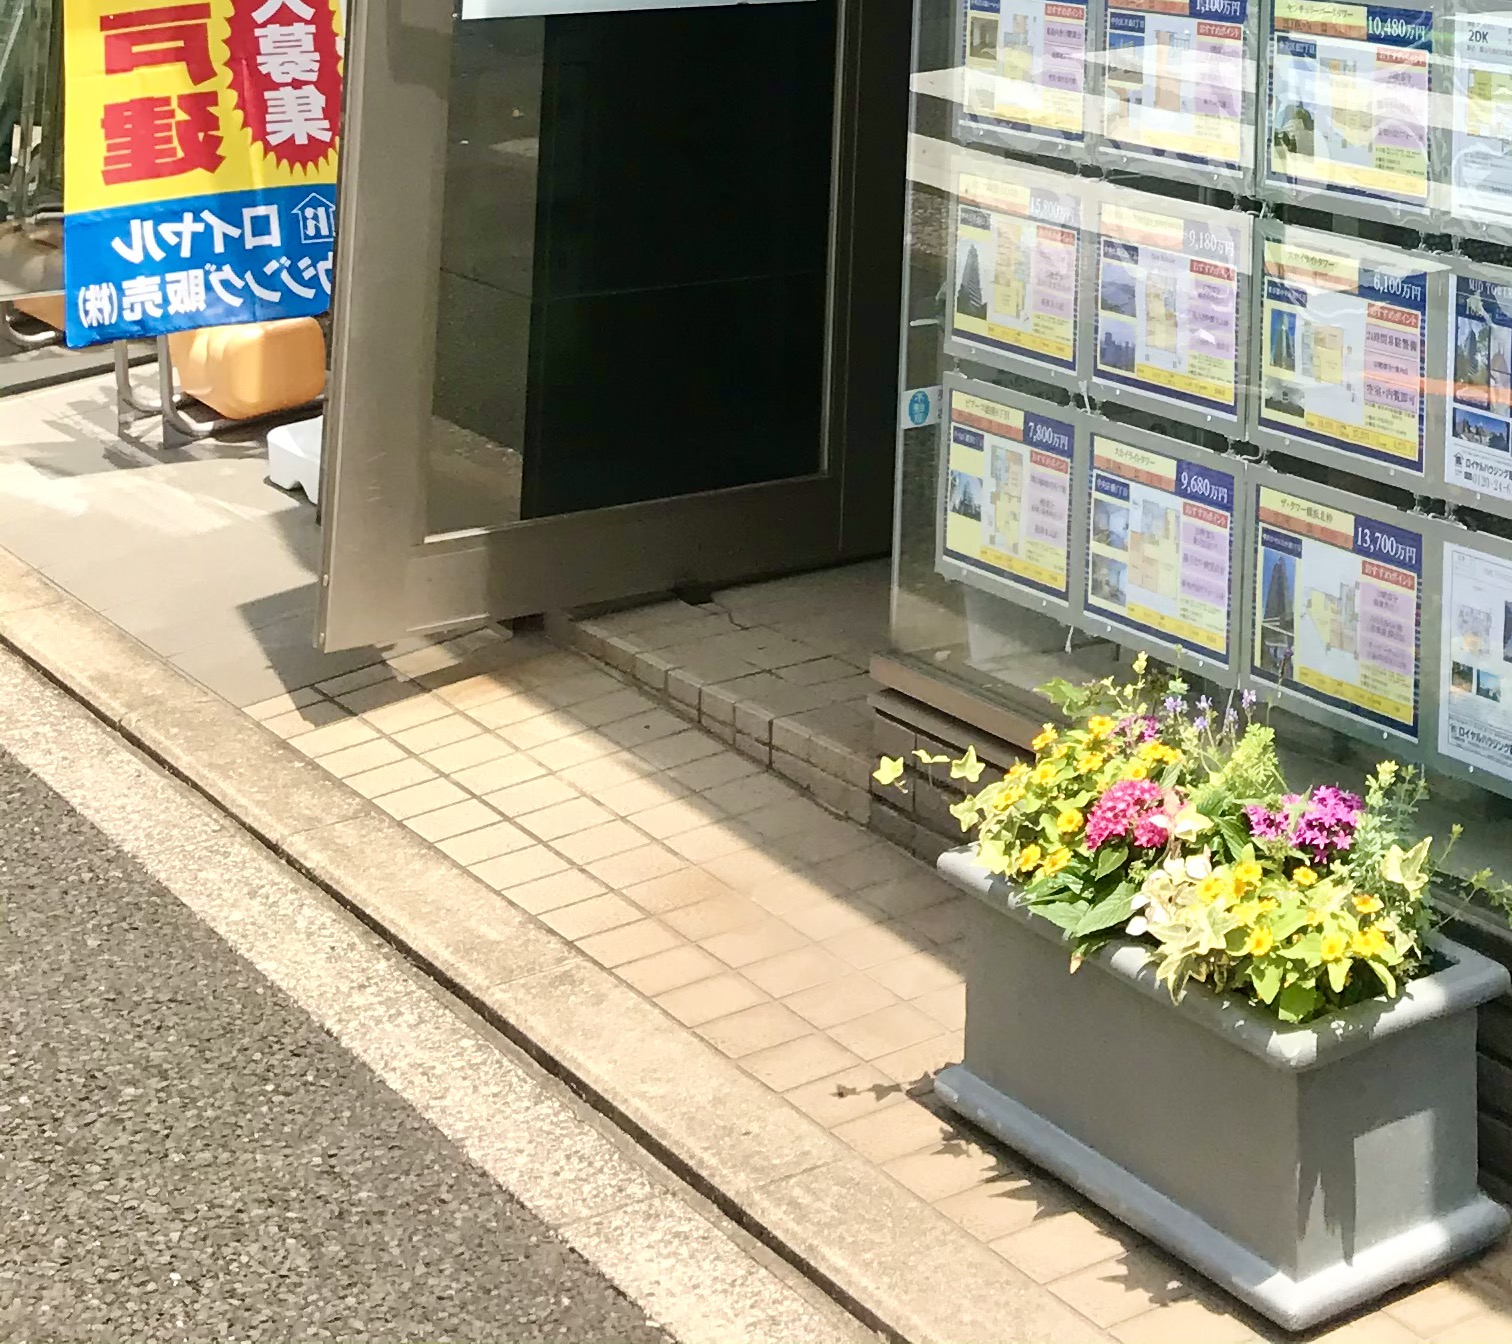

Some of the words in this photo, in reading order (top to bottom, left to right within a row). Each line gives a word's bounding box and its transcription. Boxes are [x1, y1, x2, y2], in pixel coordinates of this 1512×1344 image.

[1368, 15, 1426, 40] 10,480万円
[1468, 29, 1489, 44] 2DK
[1188, 230, 1235, 257] 9,180万円
[1373, 274, 1422, 302] 6,100万円
[1028, 421, 1069, 451] 7,800万円
[1181, 471, 1228, 504] 9,680万円
[1357, 527, 1417, 565] 13,700万円
[1364, 564, 1414, 587] おすすめポイント
